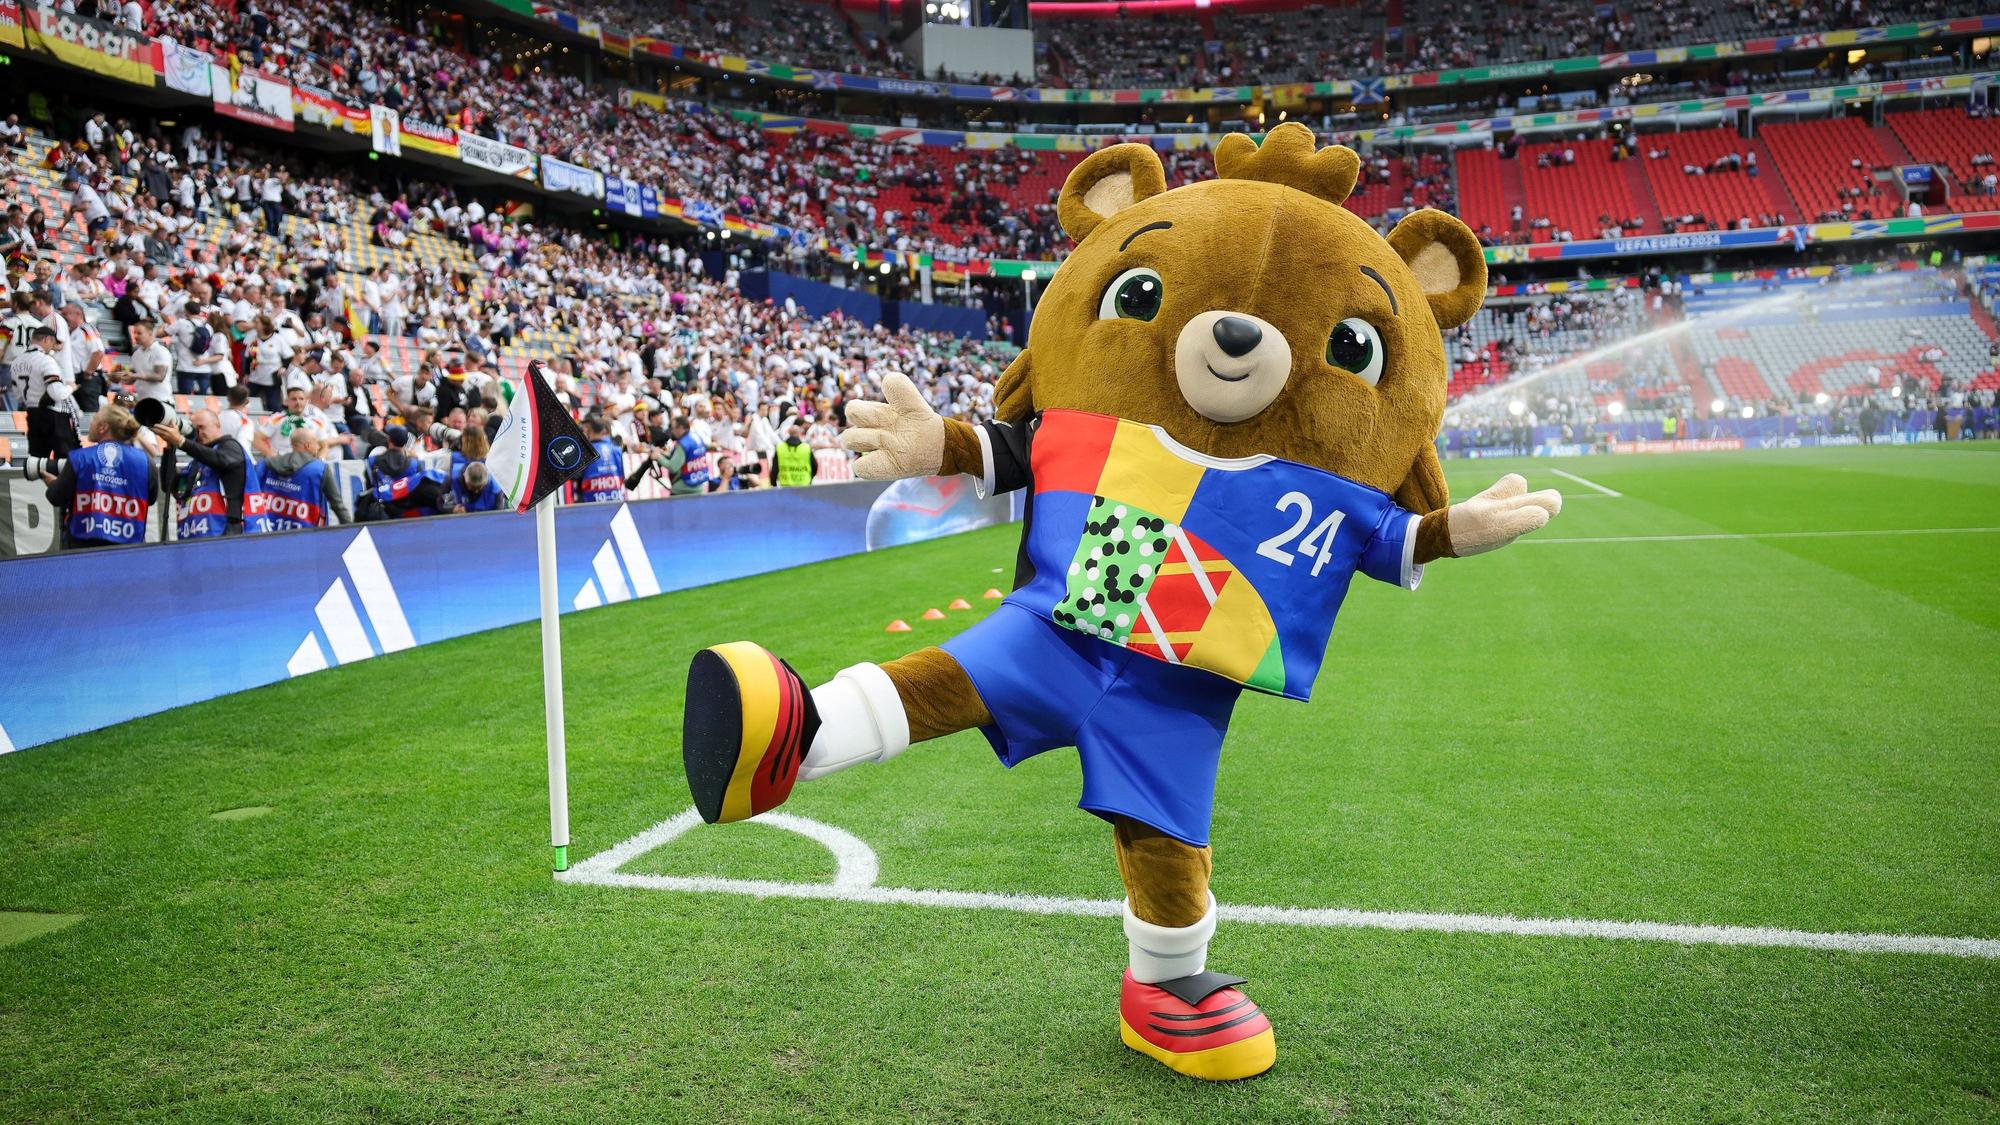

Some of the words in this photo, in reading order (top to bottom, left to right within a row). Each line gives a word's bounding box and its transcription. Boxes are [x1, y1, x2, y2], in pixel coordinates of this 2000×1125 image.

[519, 416, 527, 459] MUNICH
[76, 492, 139, 517] PHOTO
[249, 494, 309, 519] PHOTO
[1256, 491, 1346, 577] 24
